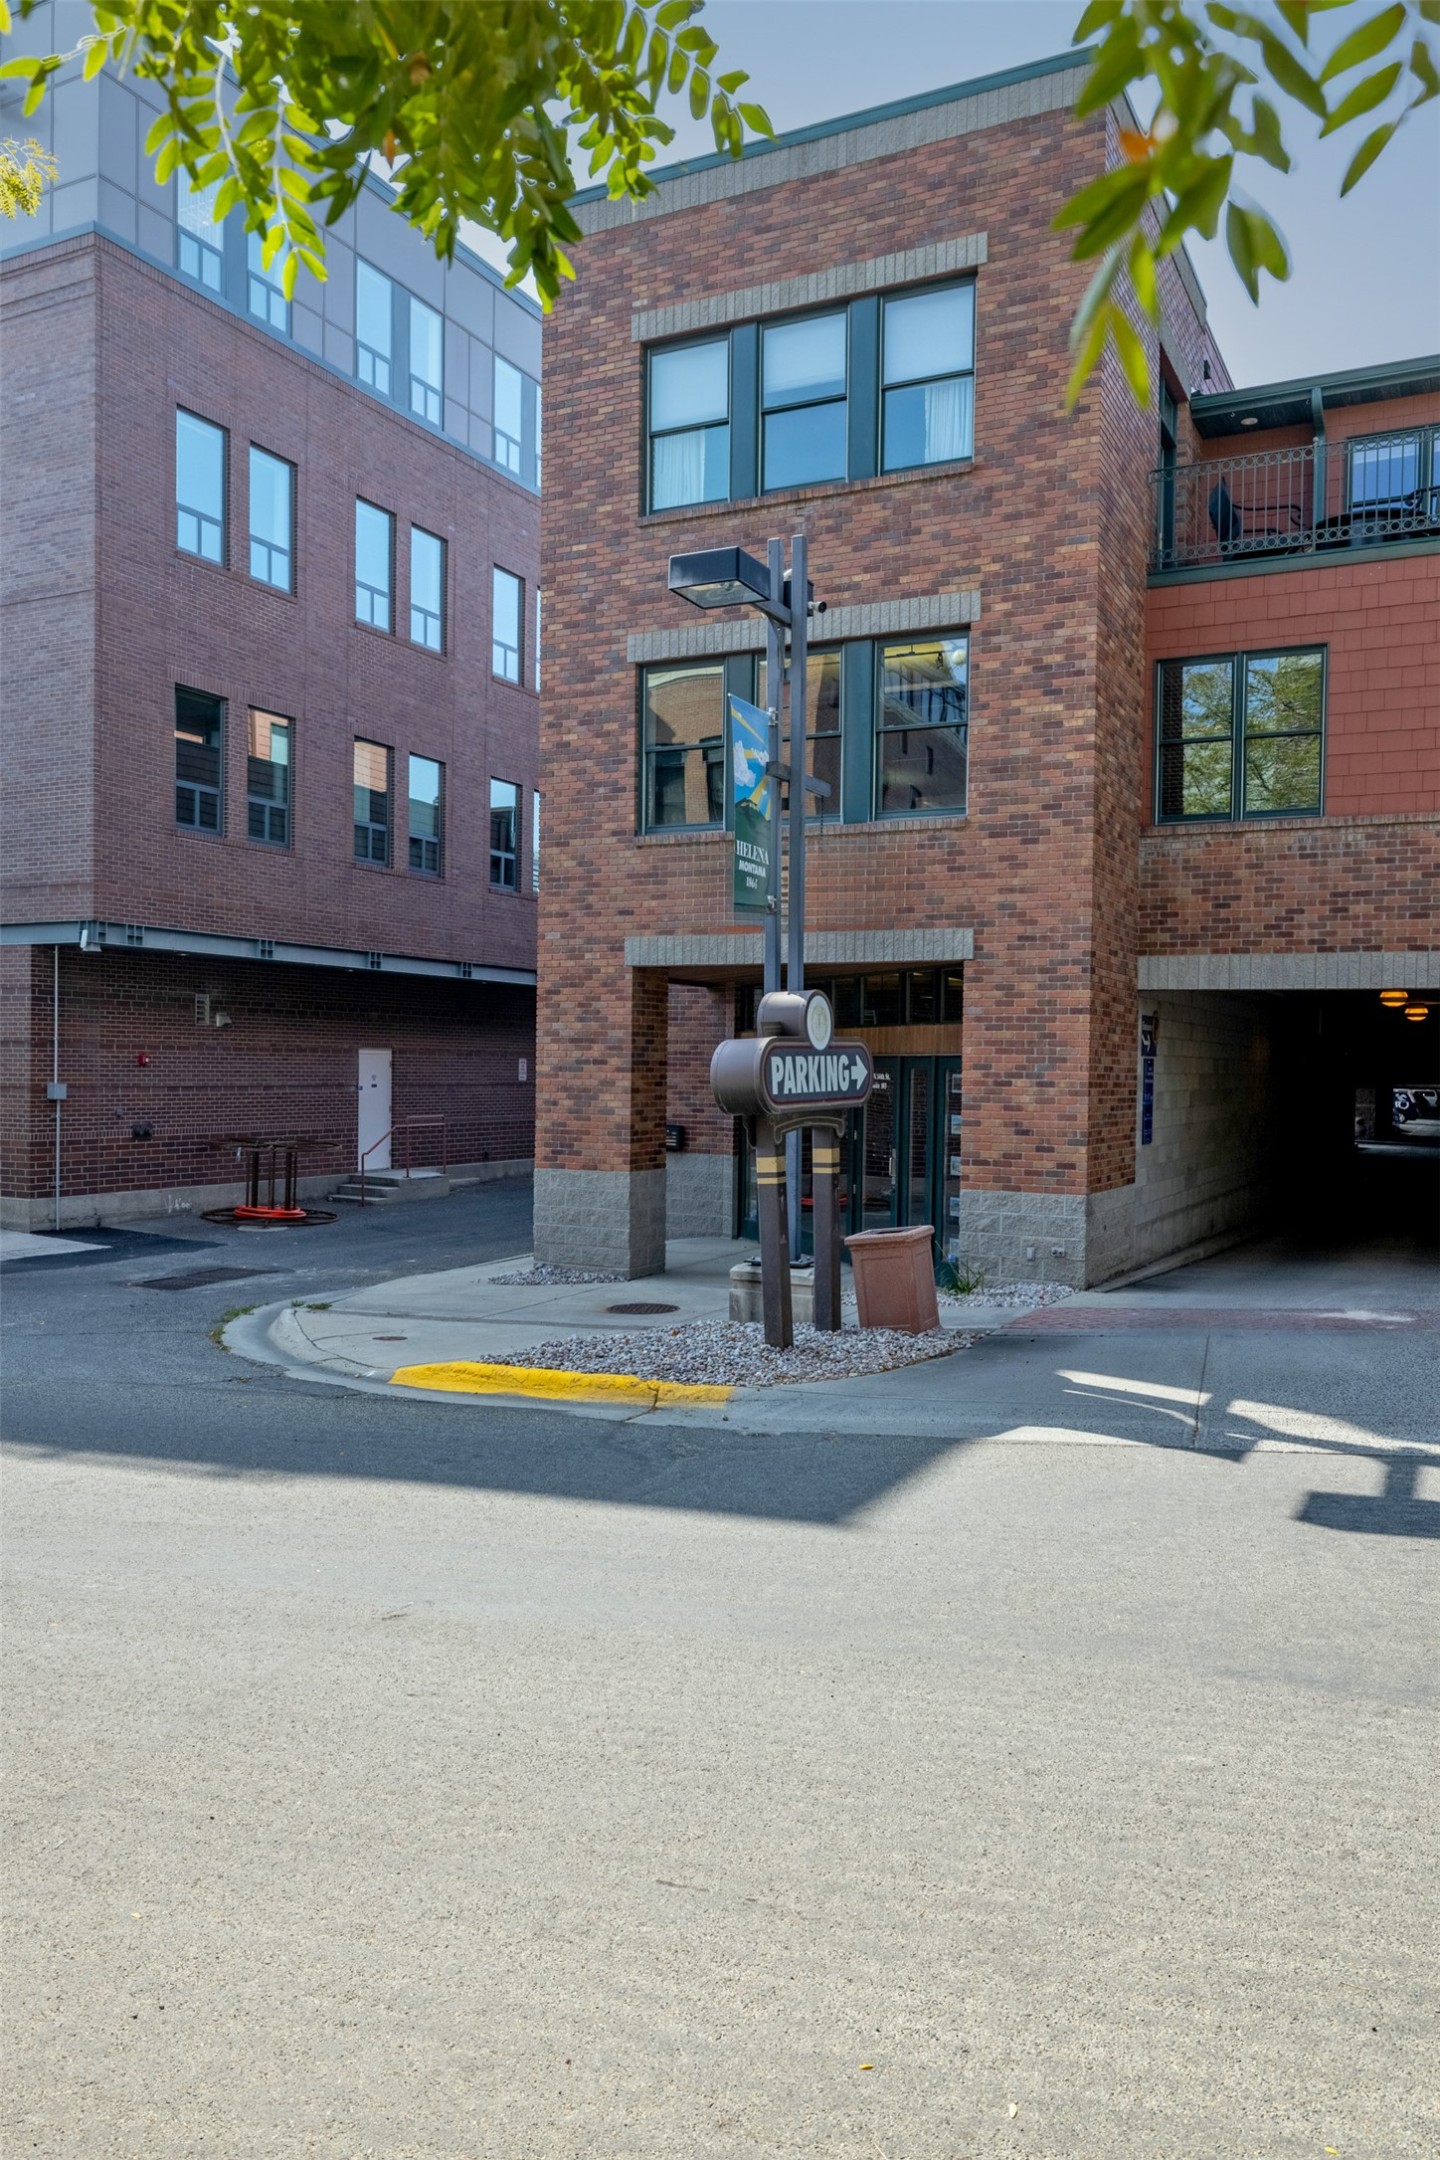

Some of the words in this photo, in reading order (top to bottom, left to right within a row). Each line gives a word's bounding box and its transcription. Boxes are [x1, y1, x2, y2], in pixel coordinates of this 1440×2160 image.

[736, 840, 769, 865] HELENA
[739, 860, 766, 878] MONTANA
[771, 1054, 849, 1095] PARKING
